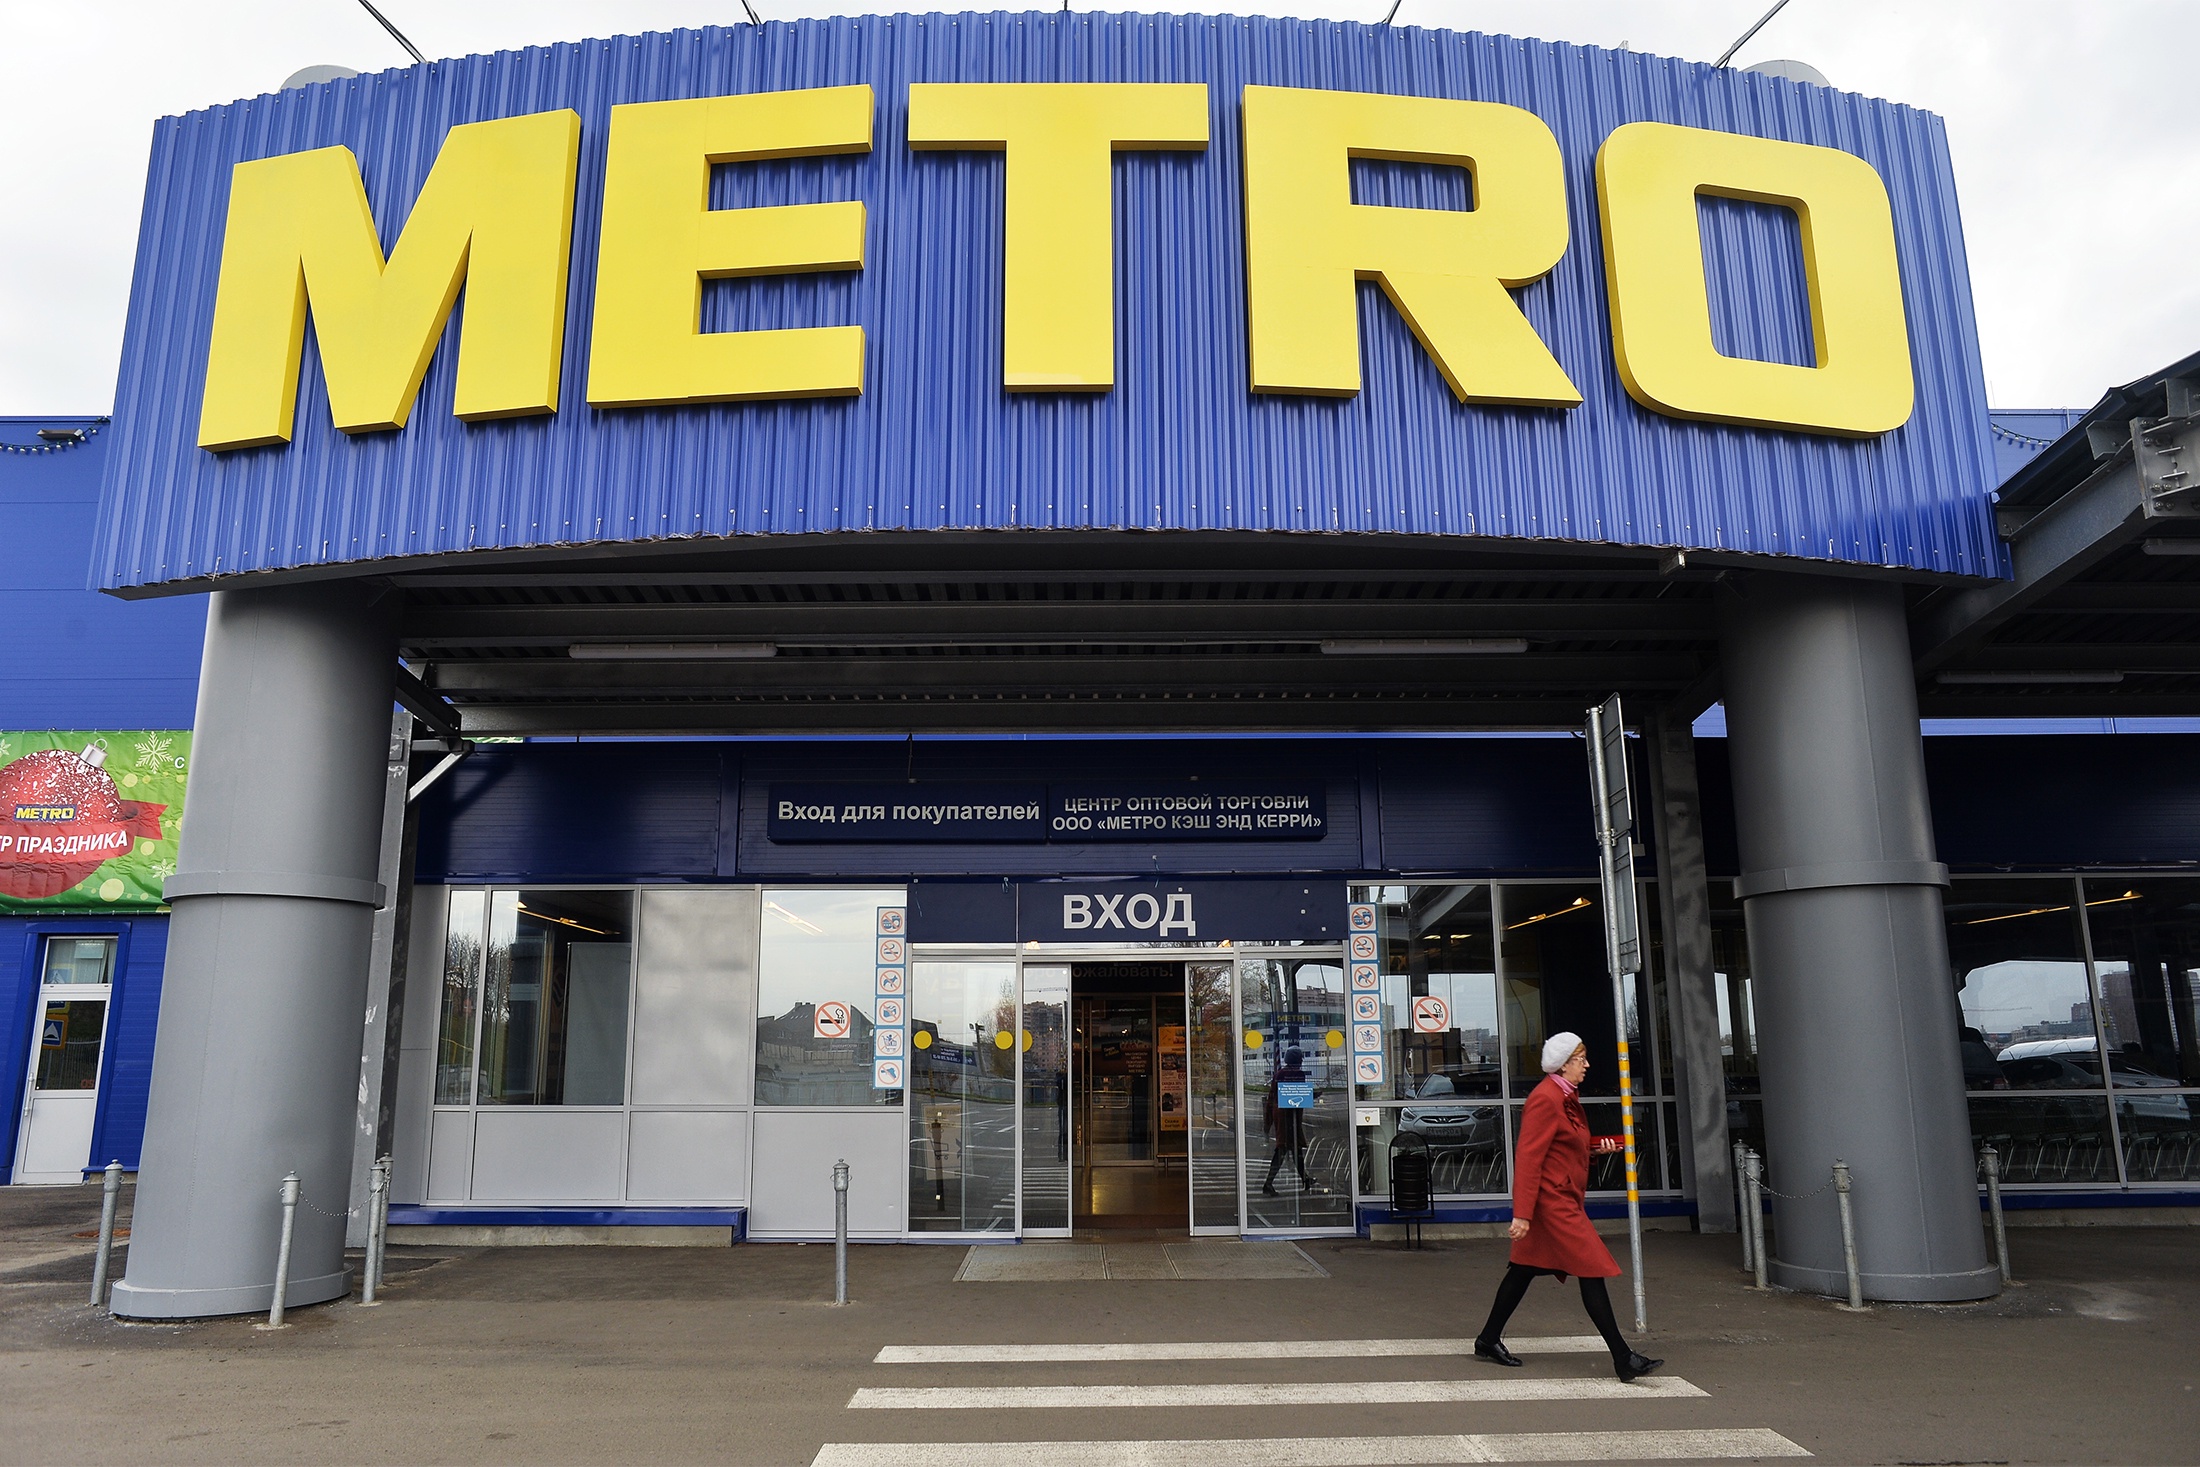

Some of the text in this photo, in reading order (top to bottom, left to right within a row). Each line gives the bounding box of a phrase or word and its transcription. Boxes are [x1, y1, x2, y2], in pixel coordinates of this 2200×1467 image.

[197, 81, 1914, 453] METRO
[16, 807, 75, 819] METRO
[778, 801, 1040, 825] Вход для покупателей
[1064, 794, 1309, 813] ЦЕНТР ОПТОВОЙ ТОРГОВЛИ
[1052, 813, 1322, 831] ООО «МЕТРО КЭШ ЭНД КЕРРИ»
[16, 830, 128, 856] ПРАЗДНИКА
[1063, 893, 1196, 937] ВХОД
[1072, 963, 1174, 978] ожаловать!
